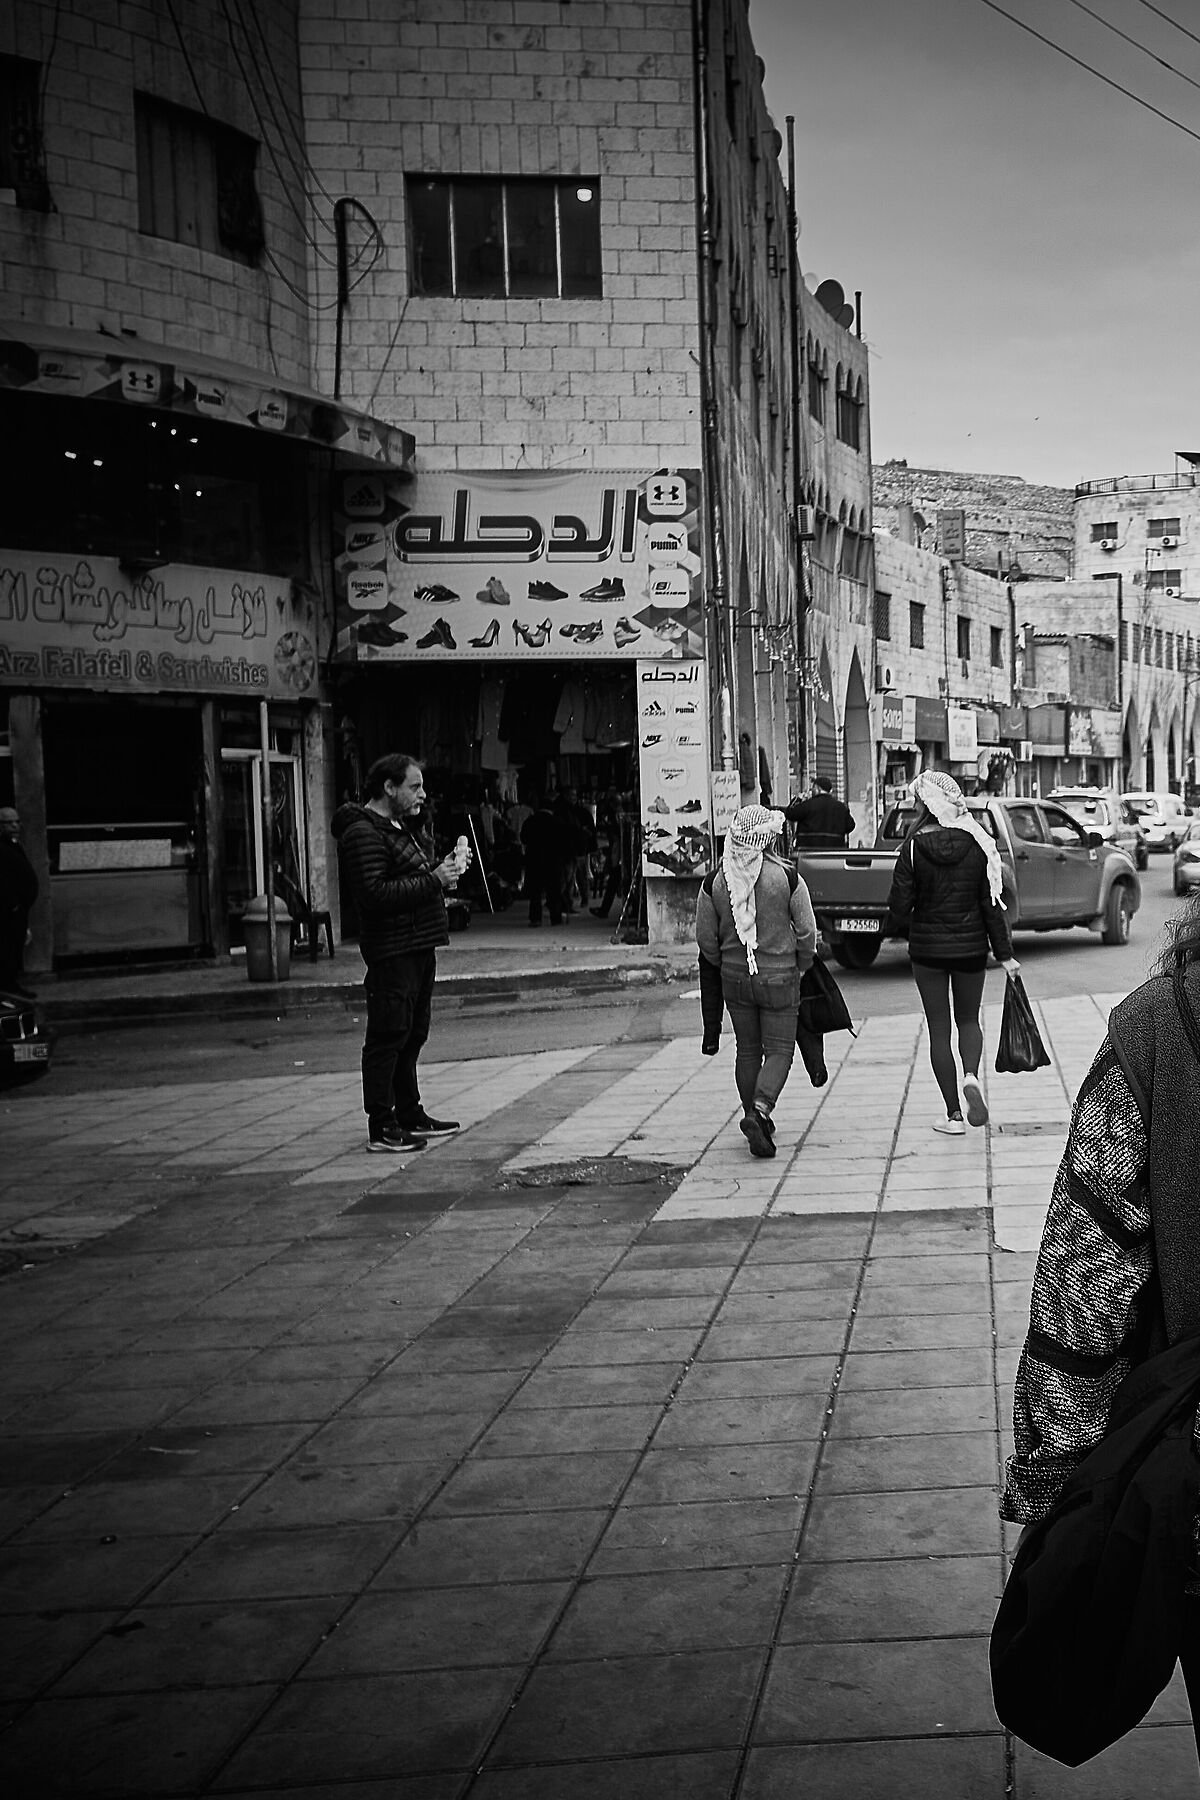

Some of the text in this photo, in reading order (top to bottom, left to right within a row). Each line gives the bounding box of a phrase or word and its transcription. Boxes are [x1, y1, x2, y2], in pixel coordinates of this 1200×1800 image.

[394, 489, 637, 562] الدحله
[650, 541, 677, 551] PUMA
[43, 648, 130, 679] Falafel
[137, 652, 154, 681] &
[159, 654, 267, 686] Sandwishes
[642, 666, 699, 683] الدحله
